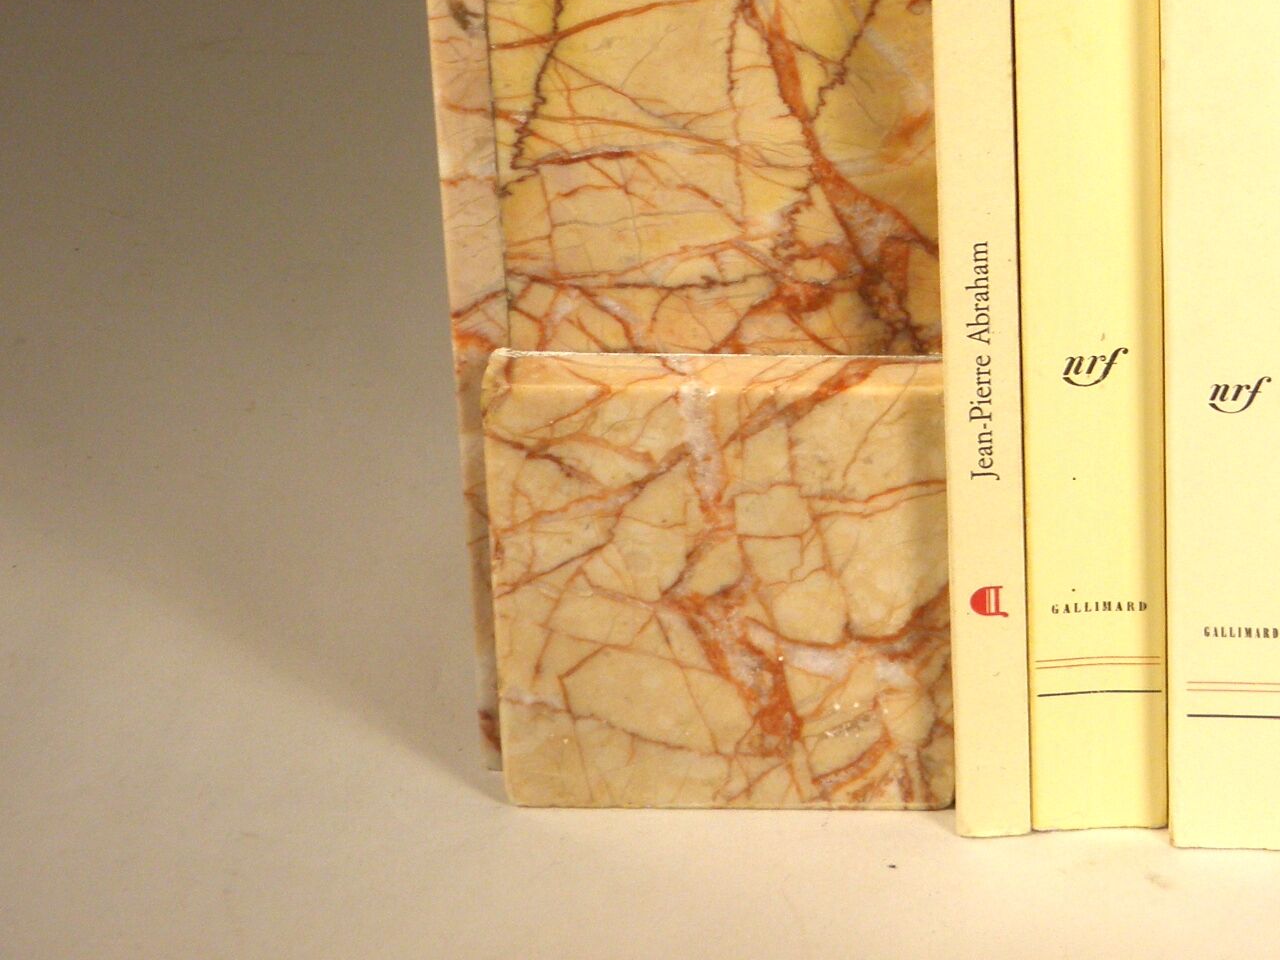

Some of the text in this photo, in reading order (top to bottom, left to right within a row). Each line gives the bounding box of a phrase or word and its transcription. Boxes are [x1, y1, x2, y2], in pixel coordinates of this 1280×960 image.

[965, 242, 1000, 480] Jean-Pierre Abraham
[1063, 348, 1128, 387] nrf
[1209, 377, 1271, 413] nrf
[1052, 602, 1148, 614] GALLIMARD
[1204, 627, 1279, 638] GALLIMARD
